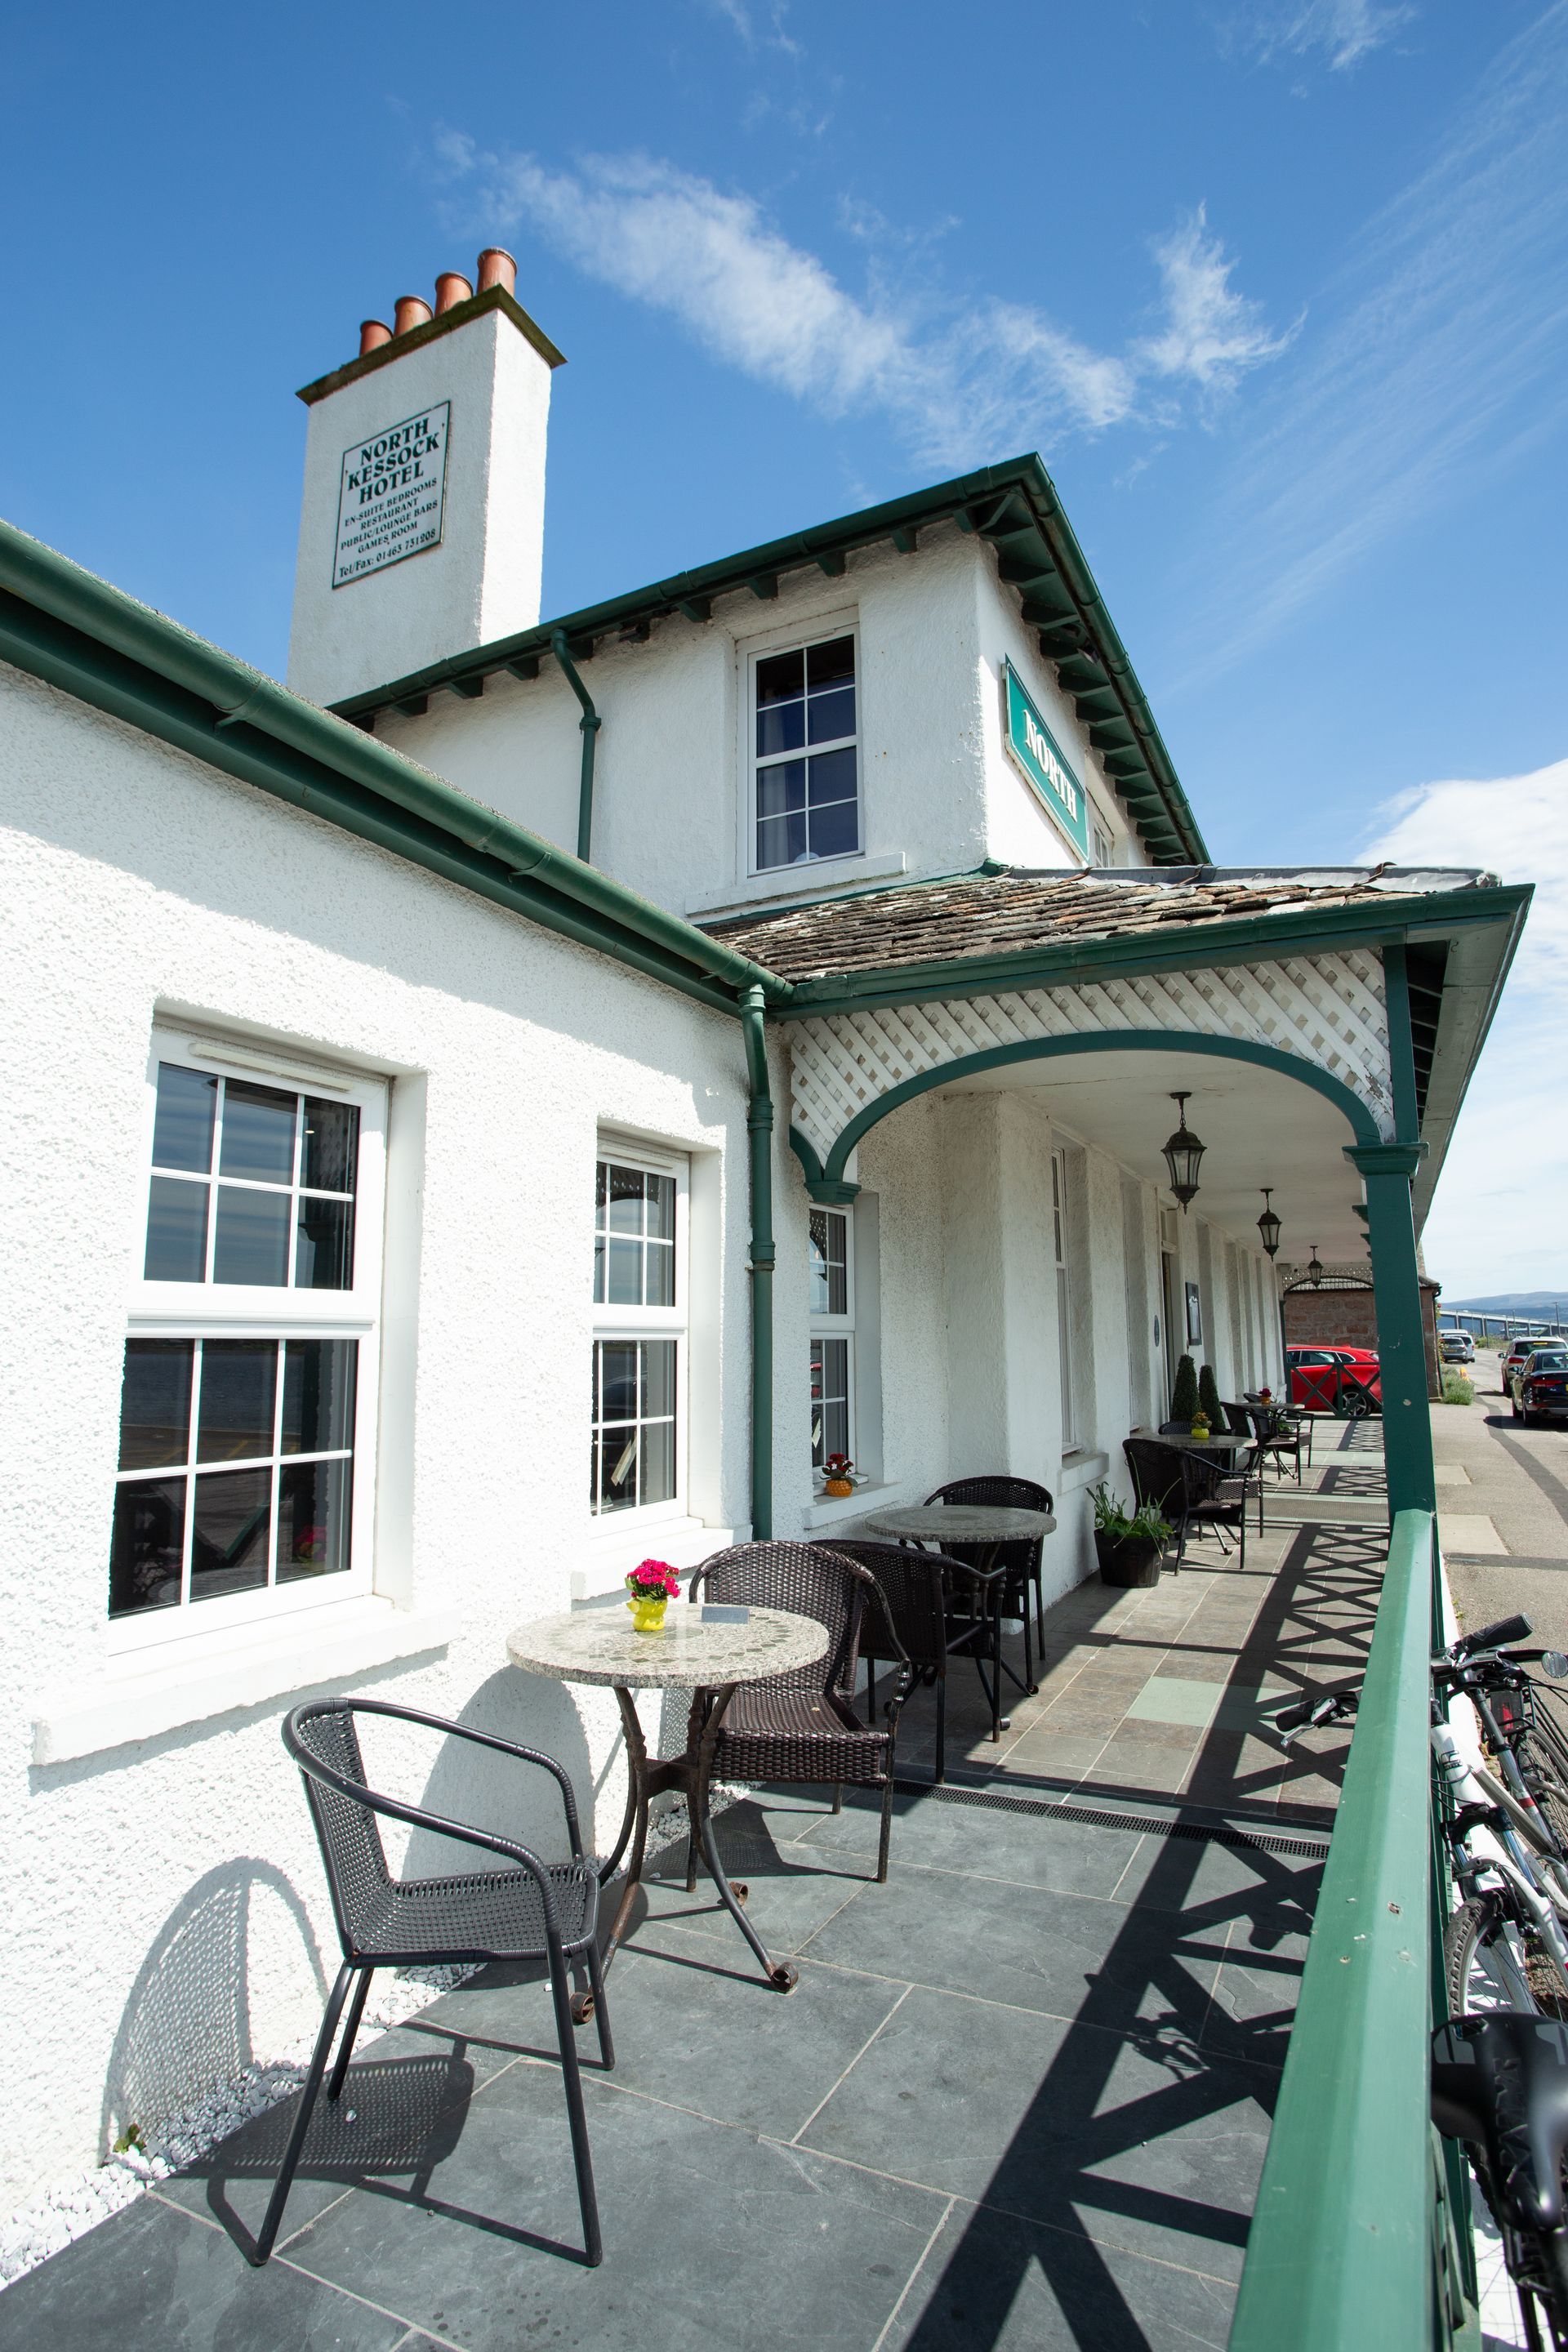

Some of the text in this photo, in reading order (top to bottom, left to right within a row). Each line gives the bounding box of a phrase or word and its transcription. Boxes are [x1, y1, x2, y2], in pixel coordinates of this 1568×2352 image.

[347, 432, 439, 492] KESSOCK
[360, 417, 430, 467] NORTH
[344, 477, 438, 528] EN-SUITE BEDROOMS
[359, 460, 425, 506] HOTEL
[340, 500, 439, 550] PUBLIC/LOUNGE BARS
[358, 521, 419, 555] GAMES ROOM
[360, 497, 419, 531] RESTAURANT
[339, 557, 375, 578] Tel/Fax:
[376, 543, 403, 562] 01463
[1022, 709, 1078, 823] NORTH
